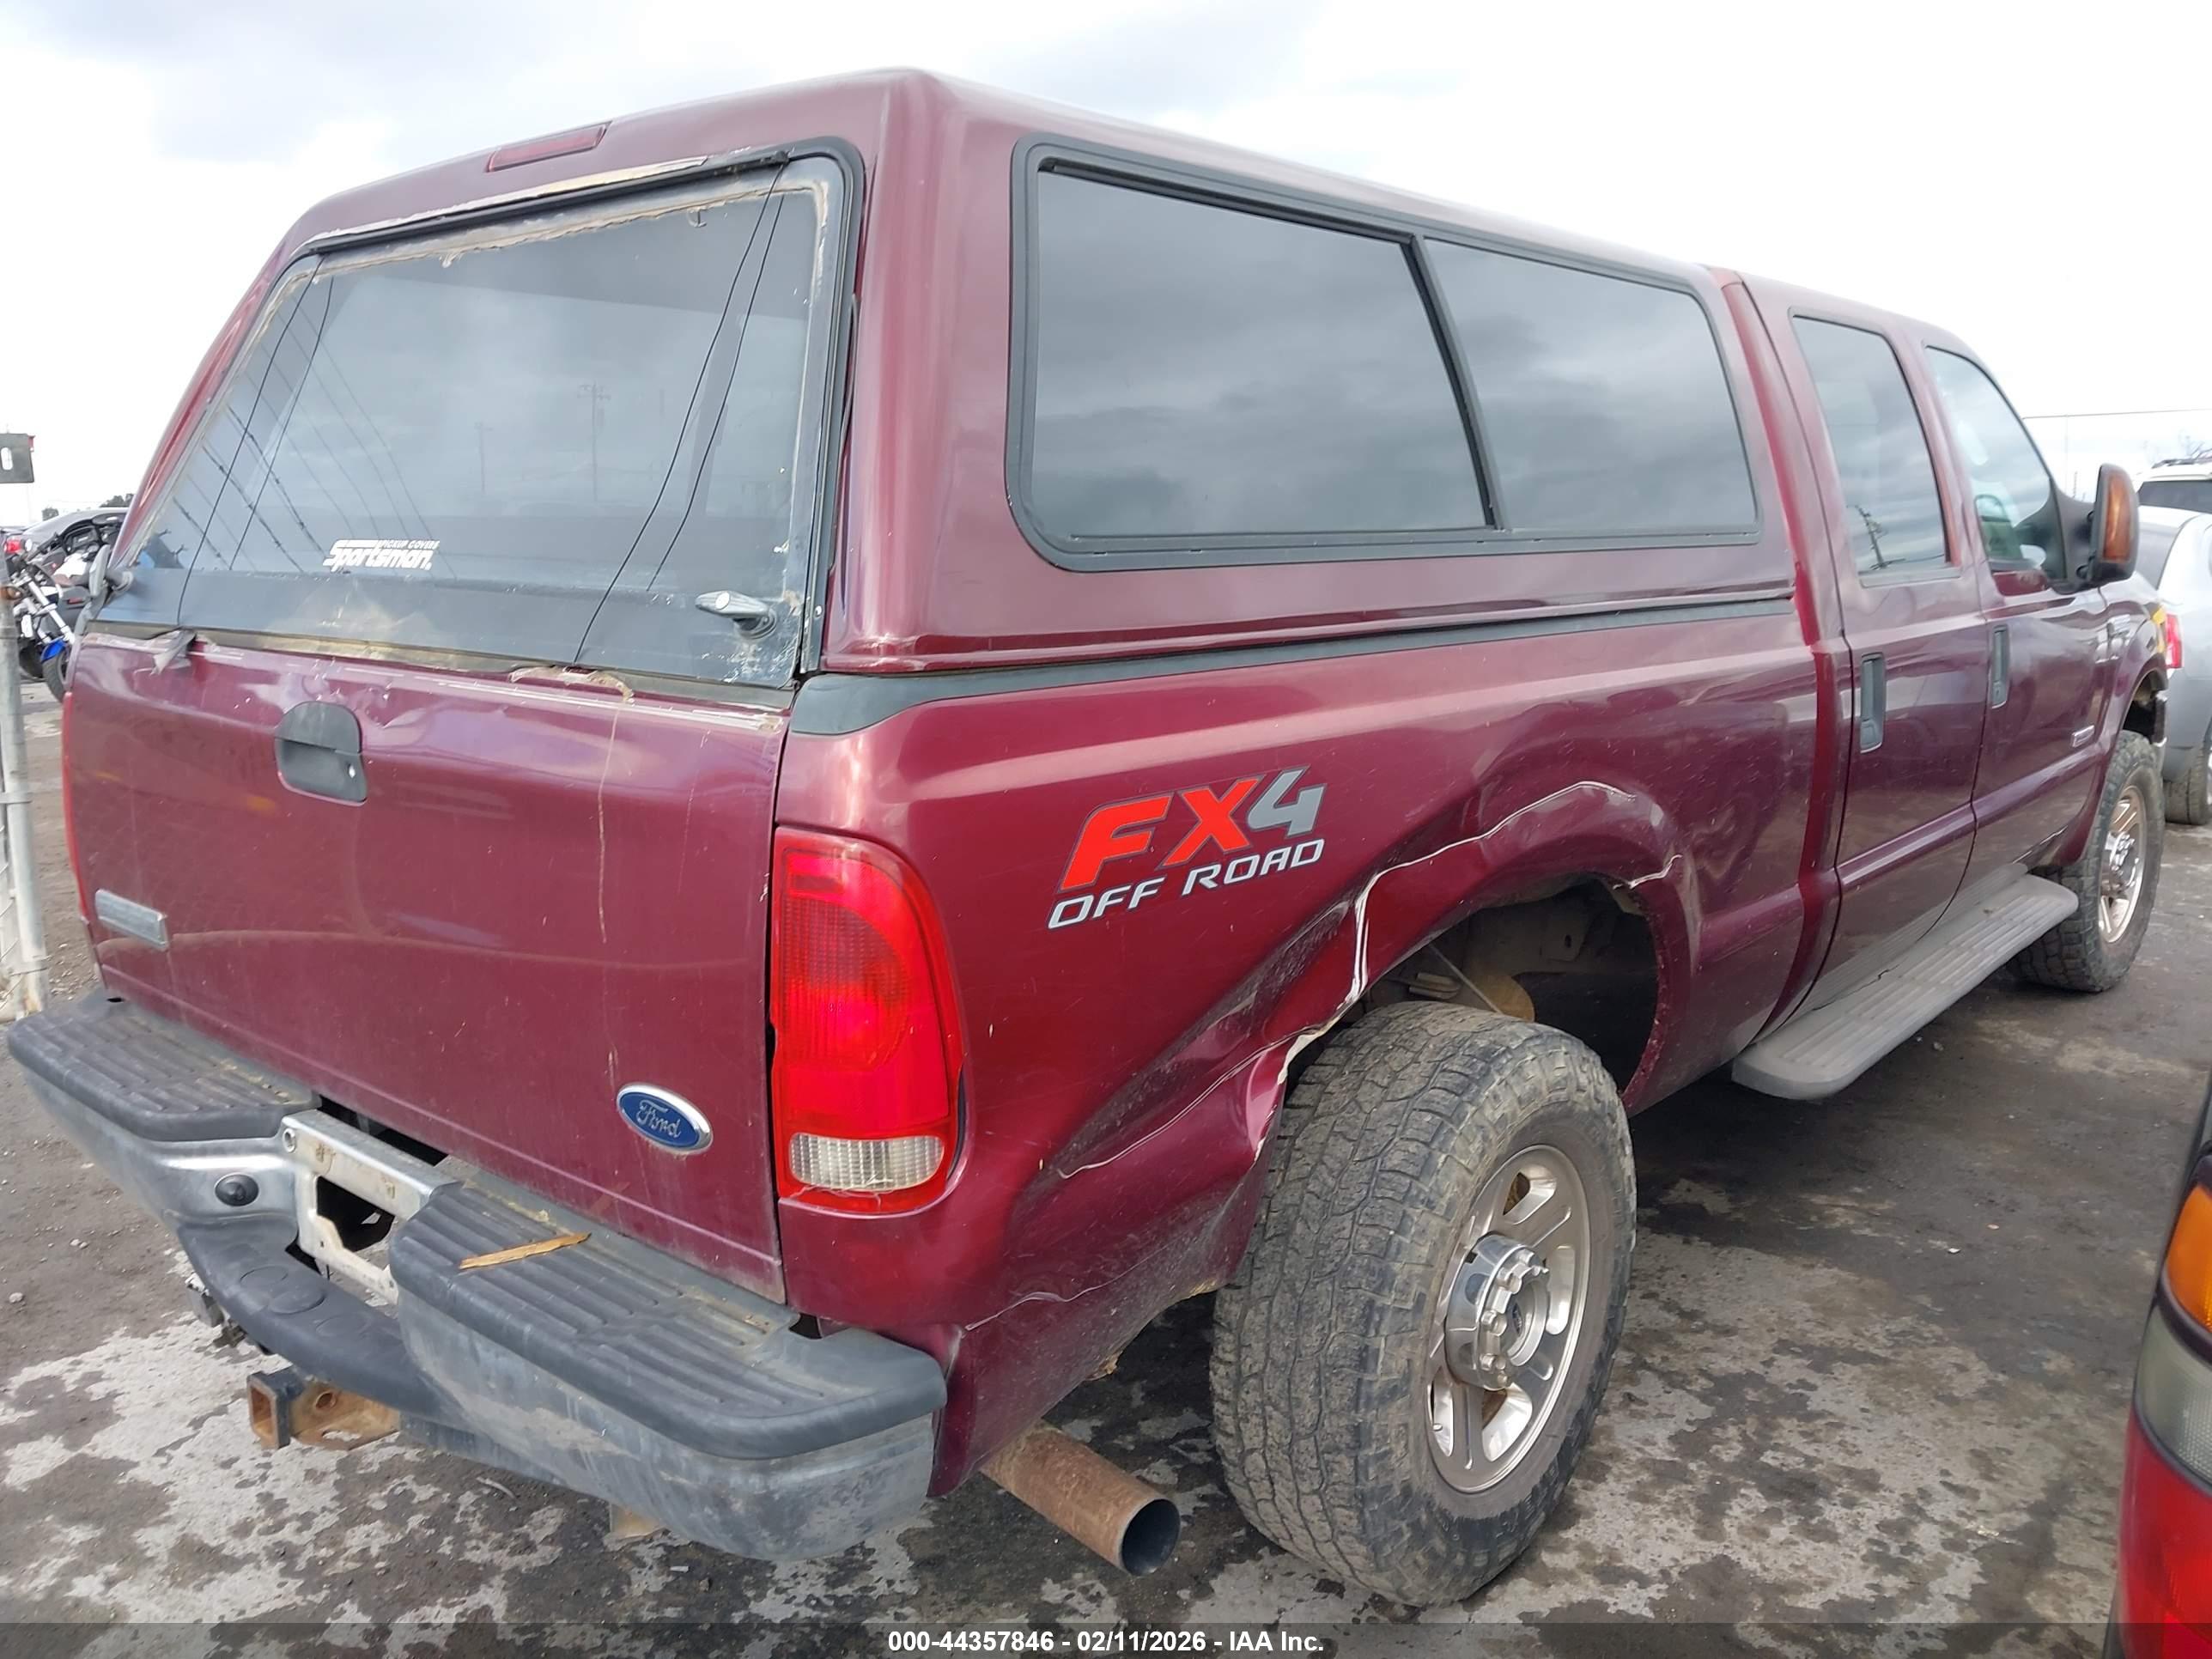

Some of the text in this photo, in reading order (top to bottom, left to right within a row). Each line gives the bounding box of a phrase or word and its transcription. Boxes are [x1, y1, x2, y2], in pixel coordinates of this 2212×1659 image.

[408, 540, 441, 550] COVERS
[1059, 765, 1327, 893] FX4
[1047, 839, 1325, 929] OFF ROAD
[635, 1100, 681, 1139] Ford
